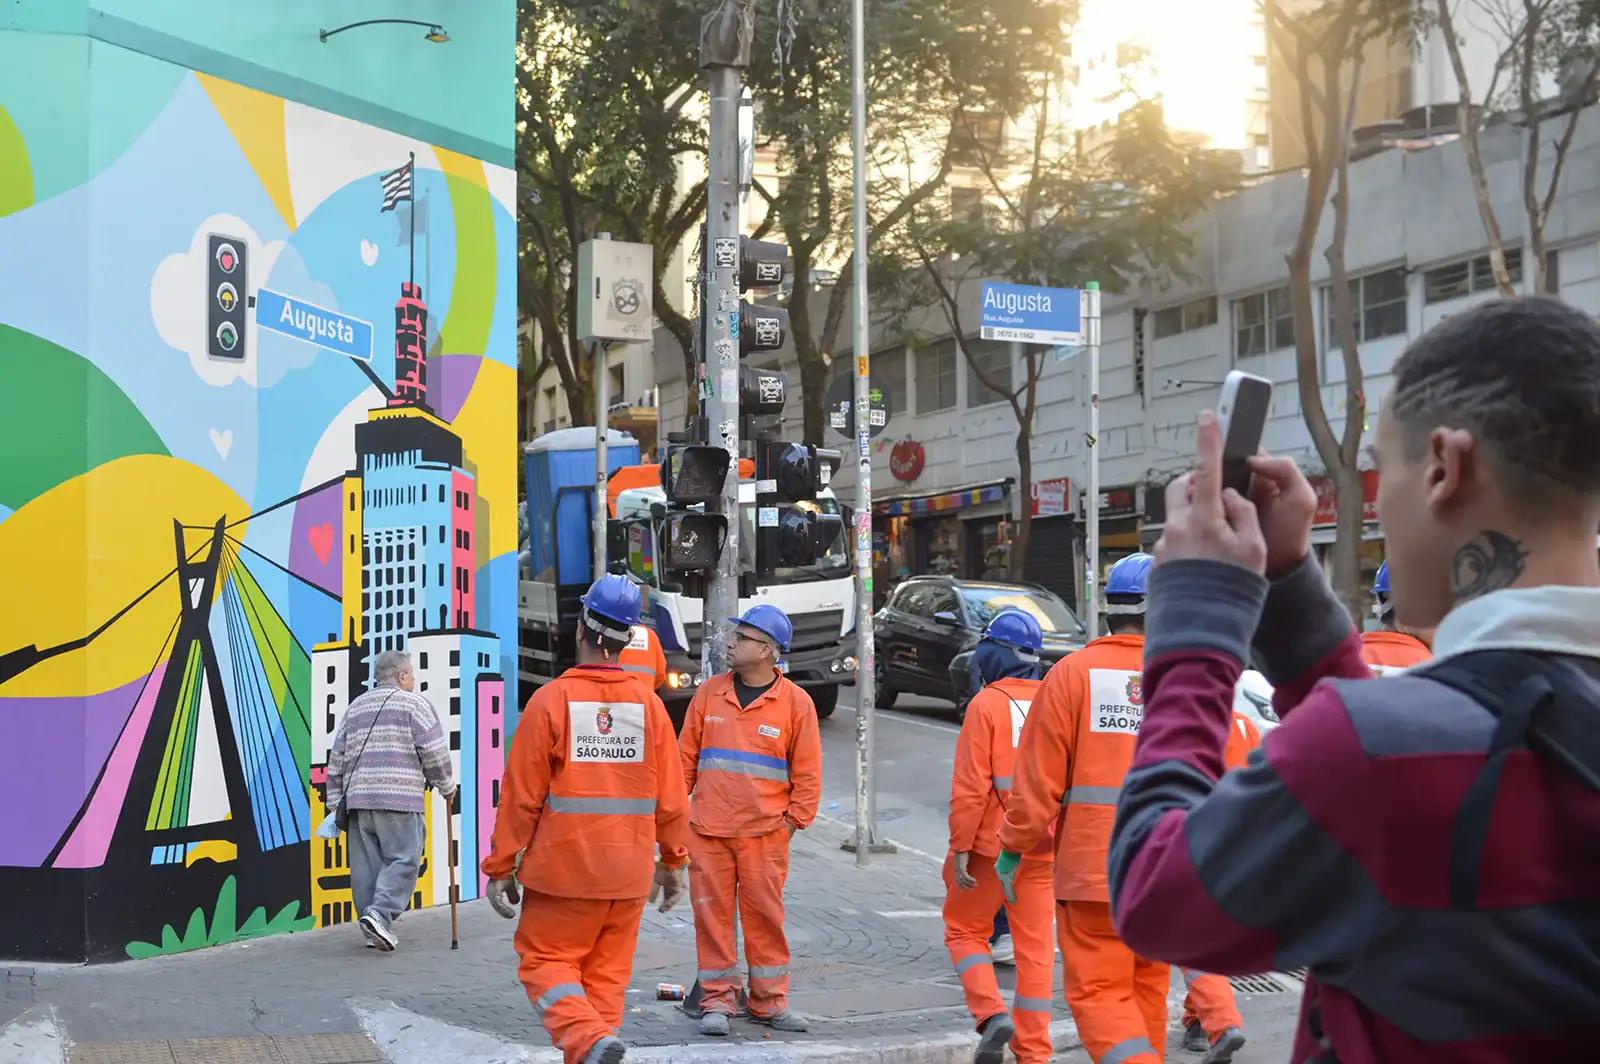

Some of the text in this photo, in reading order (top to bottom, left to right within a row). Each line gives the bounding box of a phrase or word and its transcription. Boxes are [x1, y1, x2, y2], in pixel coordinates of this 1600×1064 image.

[984, 287, 1053, 314] Augusta
[280, 300, 354, 344] Augusta
[1100, 704, 1144, 716] PREFEITU
[1099, 715, 1128, 728] SÃO
[623, 736, 636, 745] DE
[576, 745, 636, 759] SÃO PAULO
